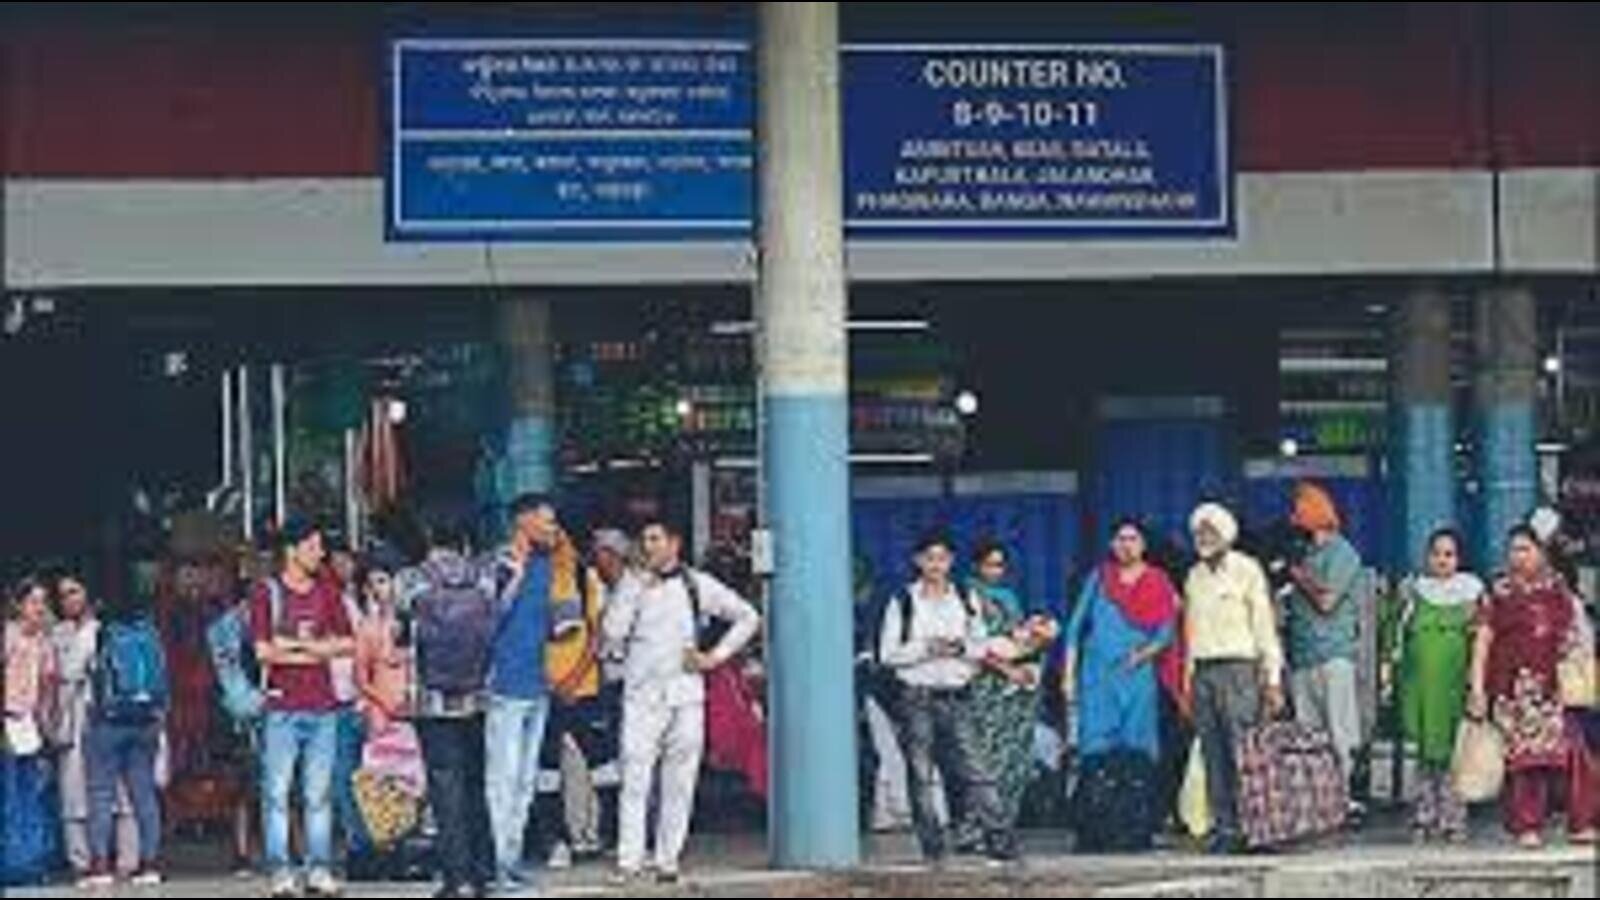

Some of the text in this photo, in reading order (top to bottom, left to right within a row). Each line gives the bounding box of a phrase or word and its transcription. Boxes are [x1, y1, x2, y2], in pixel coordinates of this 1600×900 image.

[924, 61, 1127, 89] COUNTER NO.
[952, 101, 1098, 126] 8-9-10-11
